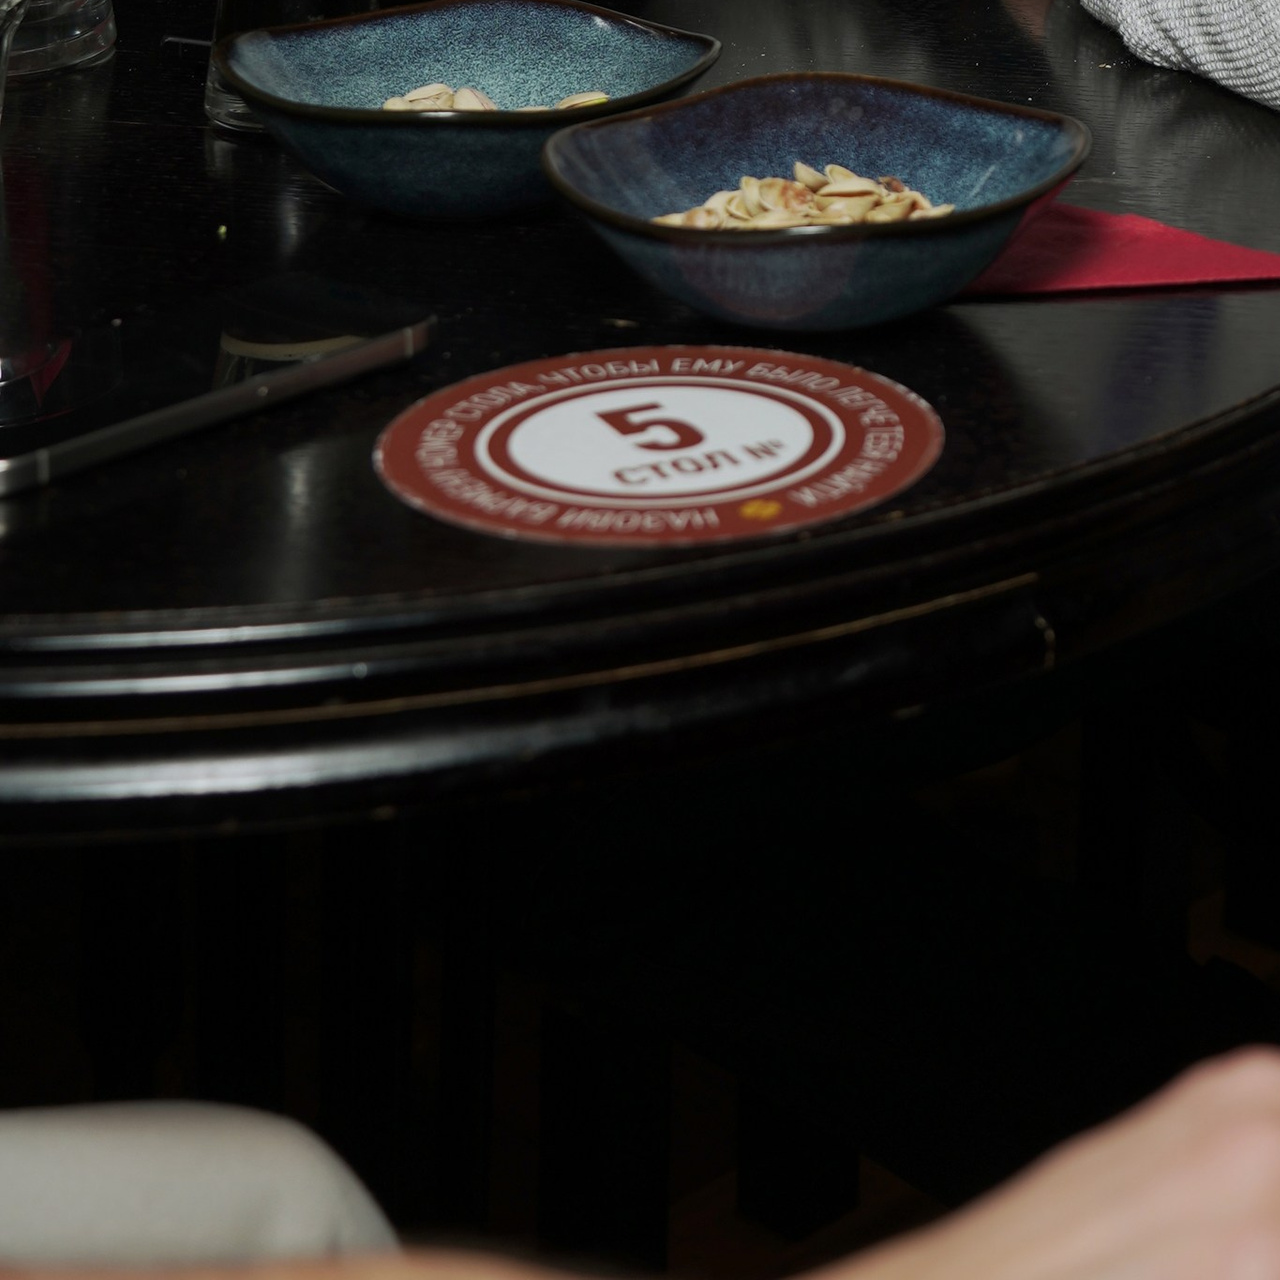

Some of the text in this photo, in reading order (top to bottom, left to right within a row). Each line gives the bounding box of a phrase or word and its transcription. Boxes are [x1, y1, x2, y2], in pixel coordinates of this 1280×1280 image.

[536, 358, 660, 386] ЧТОБЫ
[670, 356, 746, 375] ЕМУ
[744, 361, 841, 390] БЫЛО
[443, 380, 547, 423] СТОЛА,
[823, 385, 900, 427] ЛЕГЧЕ
[414, 418, 466, 469] НОМЕР
[594, 402, 705, 451] 5
[613, 449, 739, 485] СТОЛ
[555, 506, 720, 534] НАЗОВИ
